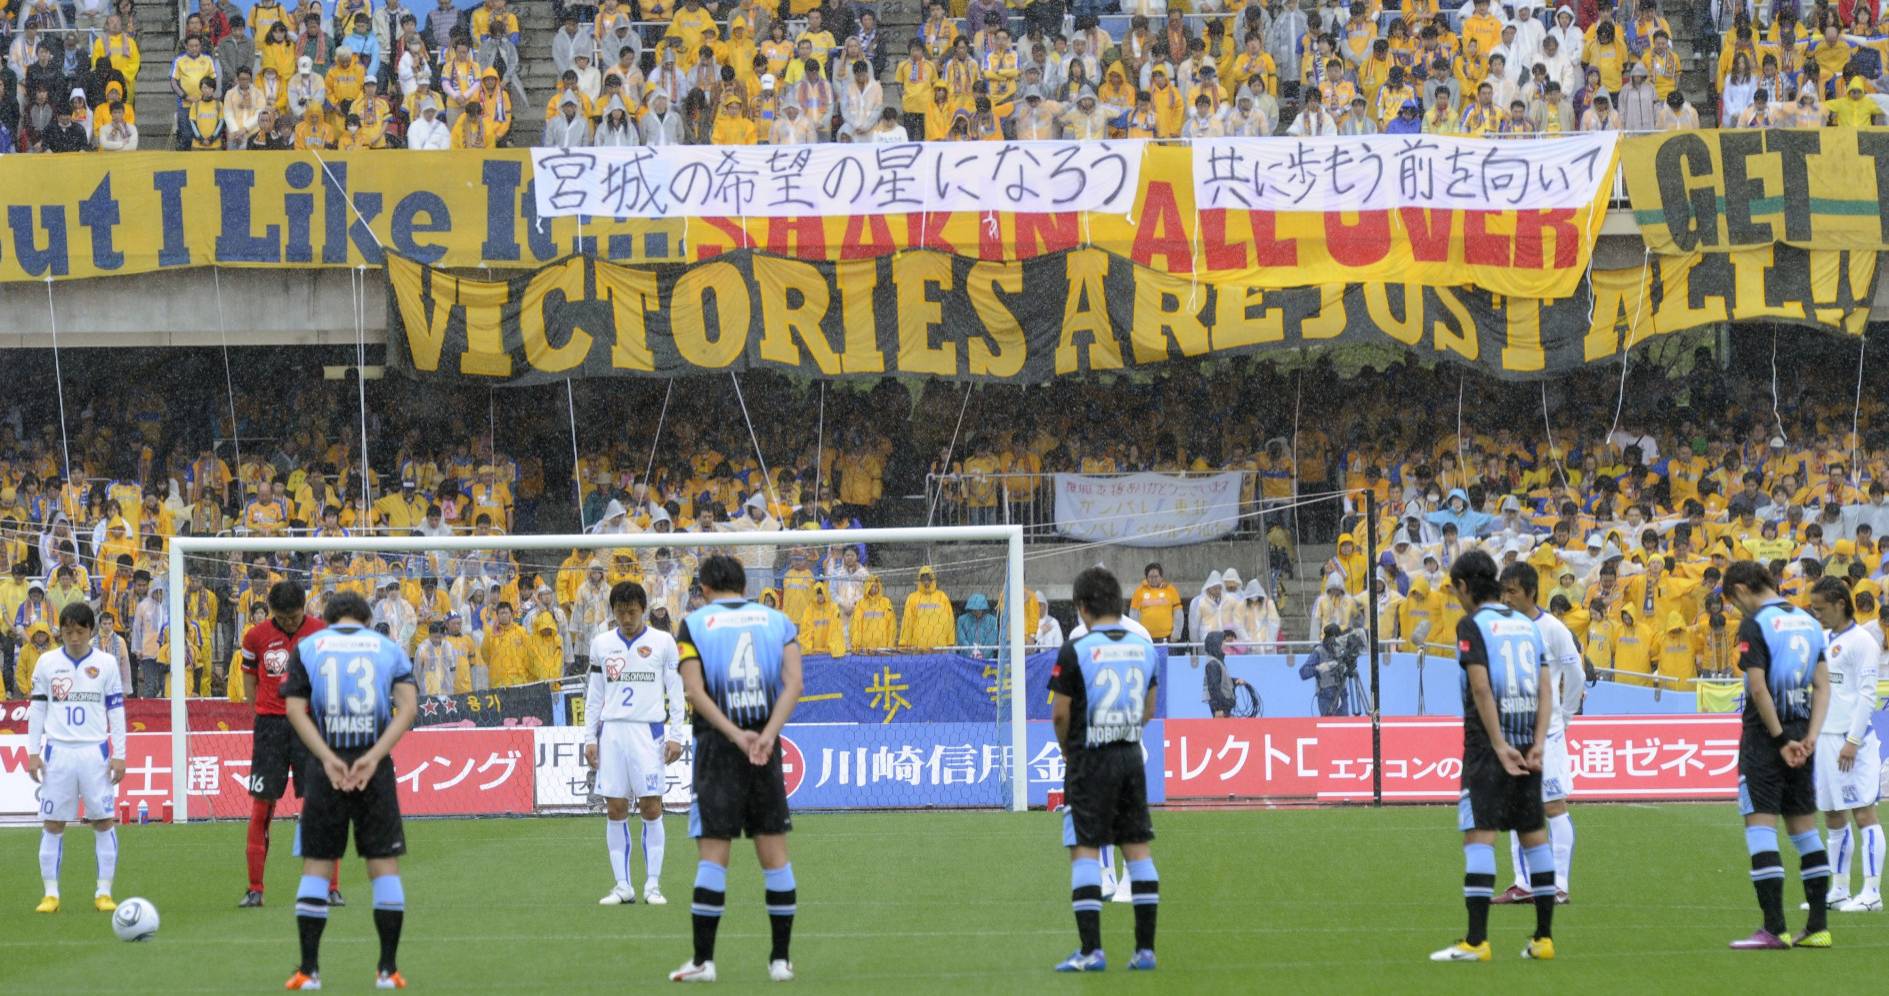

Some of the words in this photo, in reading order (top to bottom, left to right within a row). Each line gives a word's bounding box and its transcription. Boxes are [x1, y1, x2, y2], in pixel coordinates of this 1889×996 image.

[538, 142, 1128, 215] 宮城の希望の星になろう
[1202, 143, 1603, 206] 共に歩もう前を向いて
[1655, 128, 1820, 251] GET
[0, 169, 124, 276] ut
[153, 169, 190, 267] I
[215, 161, 452, 264] Like
[1130, 180, 1298, 273] ALL
[1325, 206, 1578, 270] OVER
[388, 249, 1027, 377] VICTORIES
[1055, 249, 1285, 375] ARE
[1300, 284, 1546, 372] JUST
[1585, 249, 1871, 366] ALL!!
[319, 656, 376, 715] 13
[728, 631, 760, 689] 4
[1500, 639, 1537, 695] 19
[1789, 634, 1811, 685] 3
[65, 706, 86, 727] 10
[325, 715, 375, 733] YAMASE
[621, 686, 634, 707] 2
[727, 689, 767, 709] IGAWA
[1093, 666, 1145, 726] 23
[251, 774, 264, 793] 16
[1164, 734, 1319, 781] レクトロ
[39, 799, 54, 816] 10
